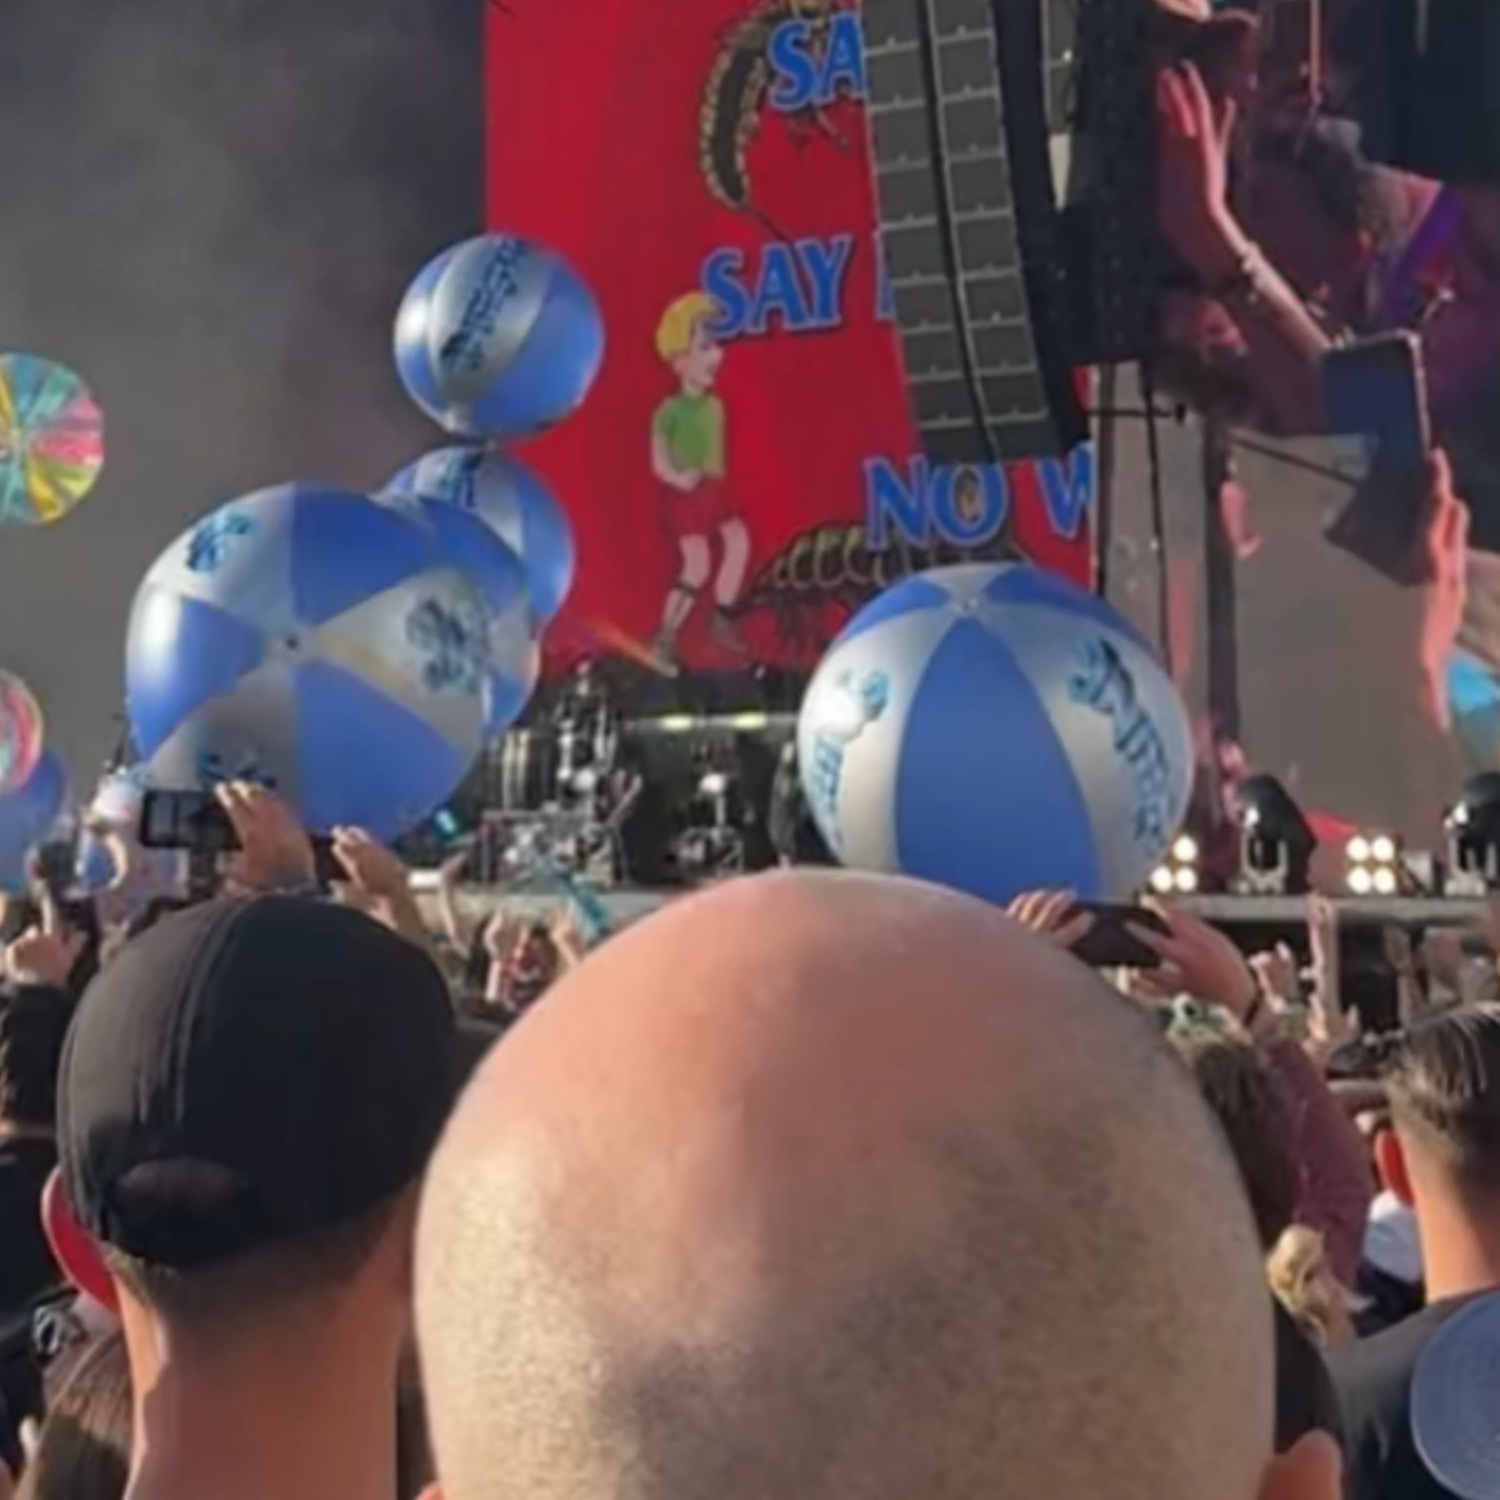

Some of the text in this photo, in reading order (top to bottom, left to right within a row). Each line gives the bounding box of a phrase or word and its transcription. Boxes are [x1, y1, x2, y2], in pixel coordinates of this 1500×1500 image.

[767, 10, 869, 112] SA
[702, 233, 854, 338] SAY
[863, 452, 1009, 551] NO
